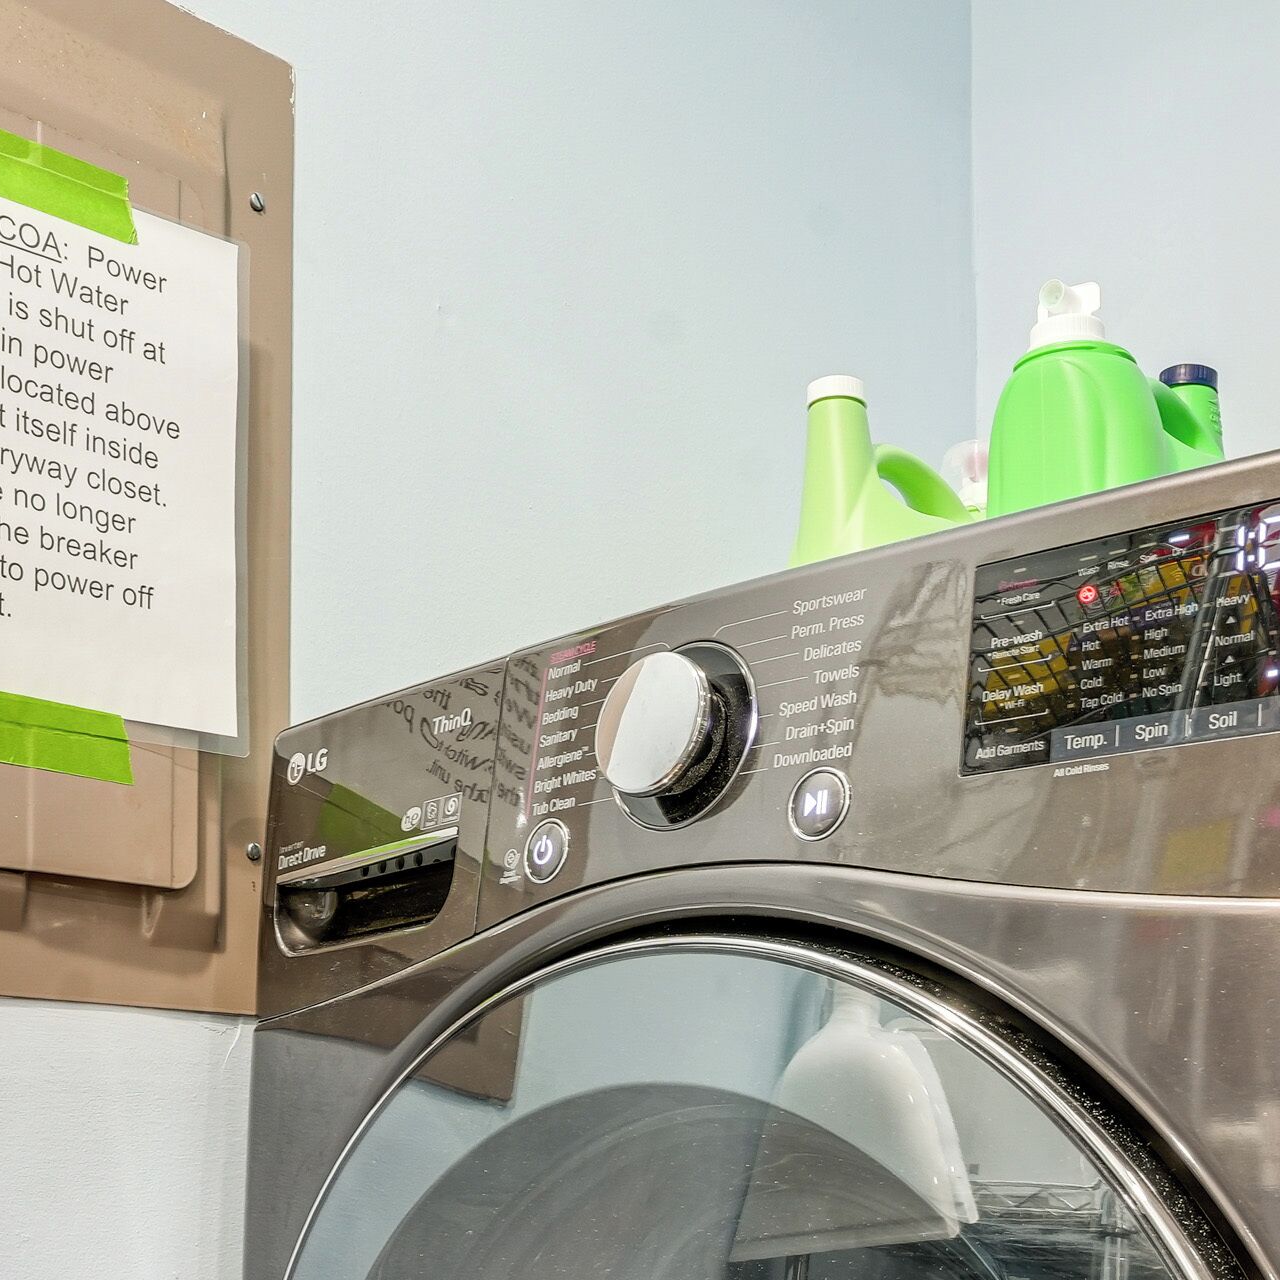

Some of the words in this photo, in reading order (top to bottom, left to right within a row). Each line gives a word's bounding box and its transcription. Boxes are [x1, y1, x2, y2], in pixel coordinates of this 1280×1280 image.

[88, 246, 167, 293] Power
[51, 268, 128, 315] Water
[9, 292, 29, 320] is
[39, 307, 95, 342] shut
[103, 329, 136, 354] off
[143, 342, 166, 364] at
[34, 343, 114, 383] power
[1, 365, 95, 415] located
[105, 401, 180, 439] above
[16, 408, 78, 446] itself
[86, 428, 158, 469] inside
[87, 468, 167, 507] closet.
[14, 488, 46, 511] no
[56, 493, 136, 534] longer
[40, 526, 138, 570] breaker
[1107, 559, 1129, 570] Rinse
[0, 554, 23, 581] to
[34, 567, 114, 601] power
[122, 585, 154, 609] off
[792, 588, 867, 616] Sportswear
[1216, 594, 1250, 608] Heavy
[1145, 609, 1173, 621] Extra
[1175, 602, 1199, 616] High
[791, 622, 826, 640] Perm.
[829, 614, 865, 631] Press
[1083, 620, 1109, 633] Extra
[1111, 616, 1129, 628] Hot
[1144, 628, 1168, 641] High
[990, 630, 1043, 649] Pre-wash
[1082, 640, 1101, 652] Hot
[1215, 630, 1254, 647] Normal
[803, 640, 862, 662] Delicates
[1144, 645, 1185, 660] Medium
[548, 660, 581, 680] Normal
[813, 664, 860, 684] Towels
[1082, 658, 1113, 671] Warm
[1143, 667, 1167, 679] Low
[1080, 676, 1103, 690] Cold
[1214, 672, 1242, 687] Light
[545, 686, 574, 702] Heavy
[574, 679, 598, 693] Duty
[982, 687, 1011, 702] Delay
[1013, 682, 1044, 697] Wash
[1142, 687, 1157, 698] No
[1158, 683, 1183, 697] Spin
[778, 696, 818, 718] Speed
[820, 690, 857, 709] Wash
[1080, 697, 1099, 710] Tap
[1100, 692, 1123, 705] Cold
[432, 707, 472, 735] ThinQ
[542, 706, 579, 725] Bedding
[539, 729, 578, 748] Sanitary
[785, 716, 855, 741] Drain+Spin
[1064, 734, 1107, 750] Temp.
[1135, 723, 1169, 742] Spin
[1208, 711, 1237, 729] Soil
[306, 747, 329, 773] LG
[773, 742, 853, 768] Downloaded
[975, 748, 996, 760] Add
[997, 740, 1045, 757] Garments
[1053, 767, 1065, 778] All
[1065, 765, 1083, 776] Cold
[1083, 763, 1110, 774] Rinses
[534, 776, 561, 793] Bright
[532, 802, 548, 816] Tub
[549, 797, 576, 812] Clean
[278, 850, 303, 871] Direct
[303, 845, 327, 863] Drive
